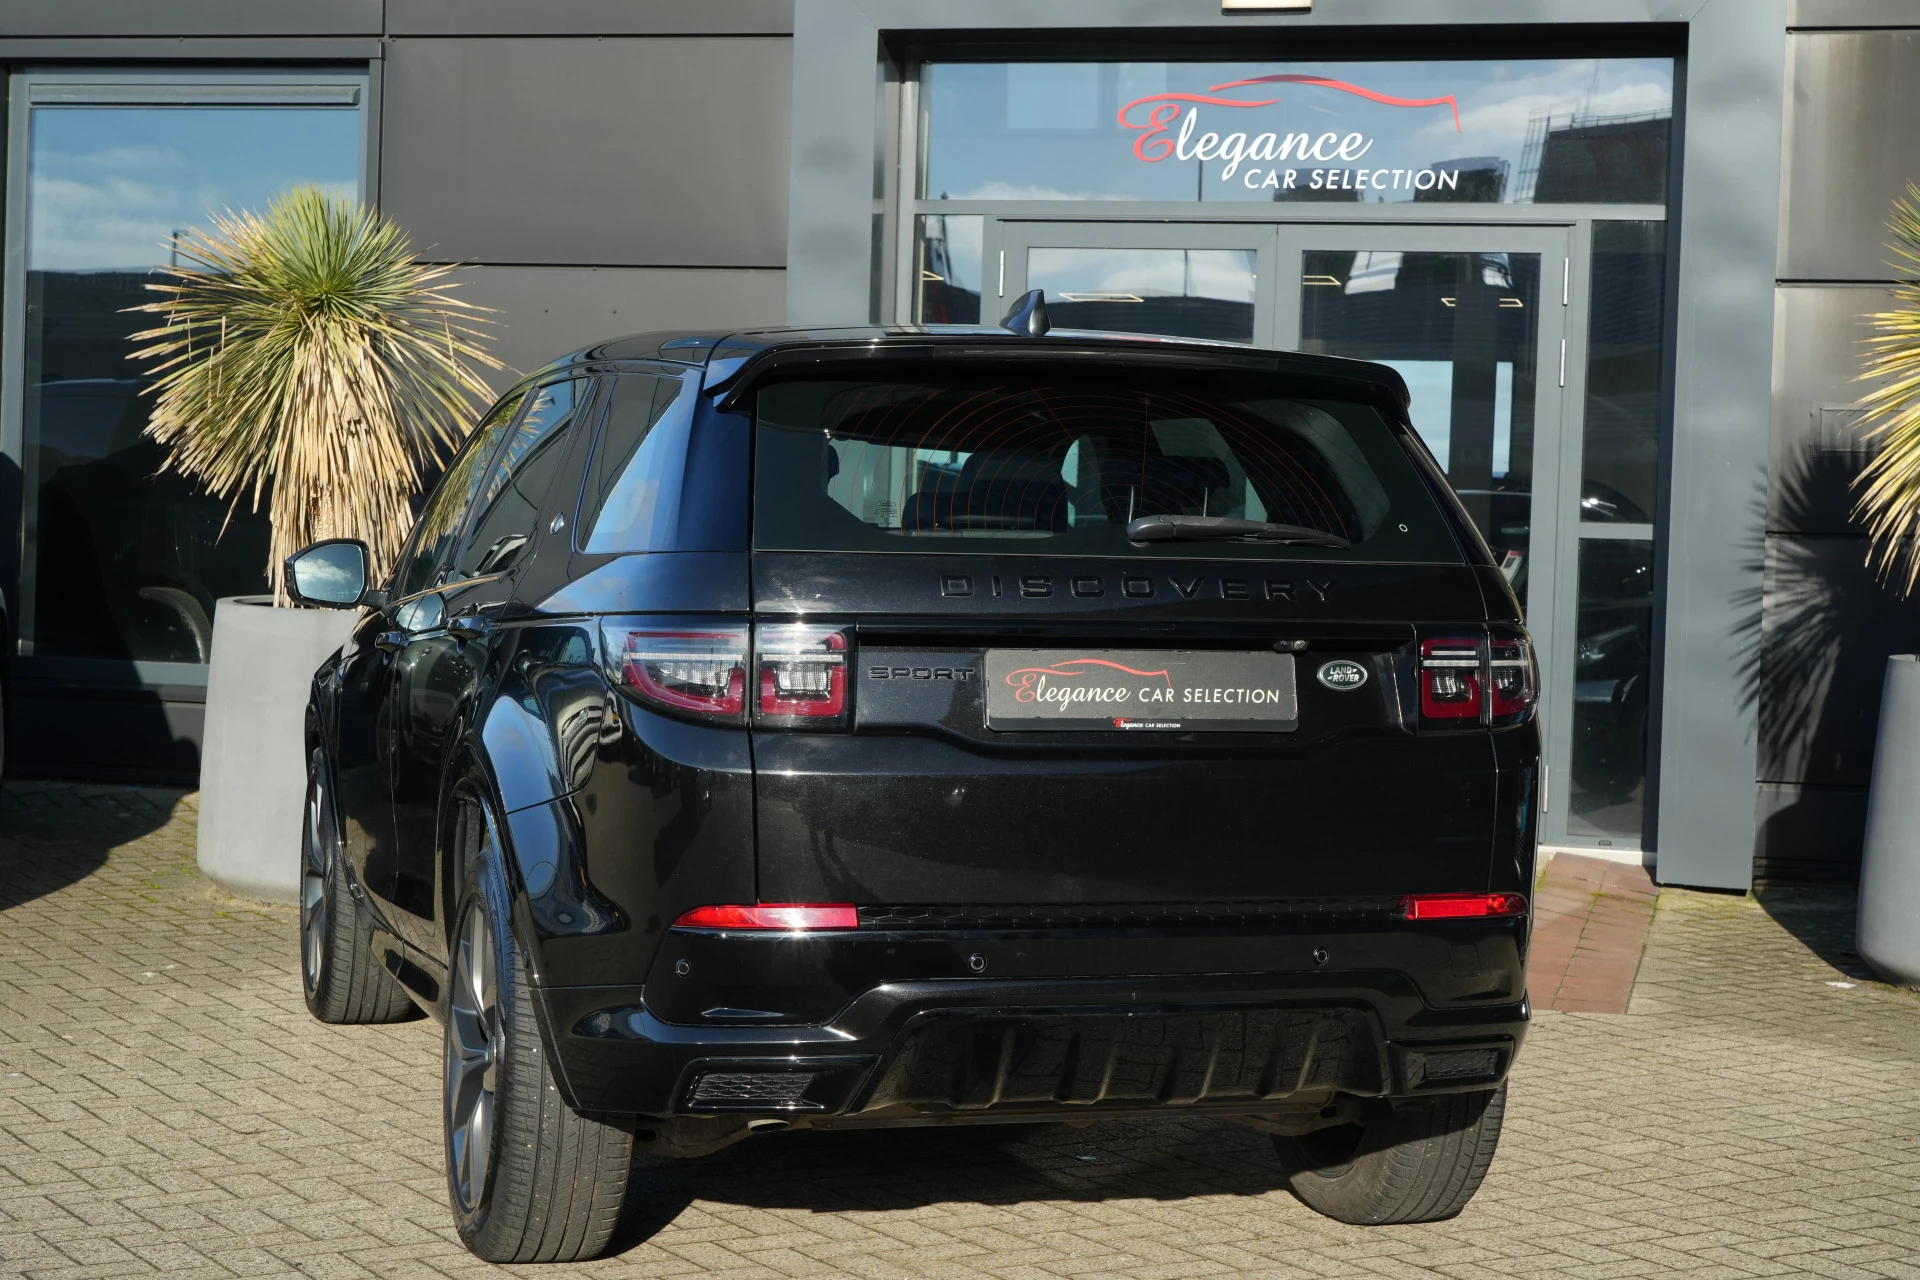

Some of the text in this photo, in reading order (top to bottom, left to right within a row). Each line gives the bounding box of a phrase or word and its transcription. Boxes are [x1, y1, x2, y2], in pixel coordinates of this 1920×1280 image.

[1117, 93, 1373, 181] Elegance
[1244, 169, 1459, 191] CAR SELECTION
[940, 575, 1337, 601] DISCOVERY
[869, 666, 975, 681] SPORT
[1330, 666, 1352, 675] LAND
[1332, 674, 1360, 682] ROVER
[1006, 668, 1279, 712] Elegance CAR SELECTION
[1113, 718, 1144, 729] Elegance
